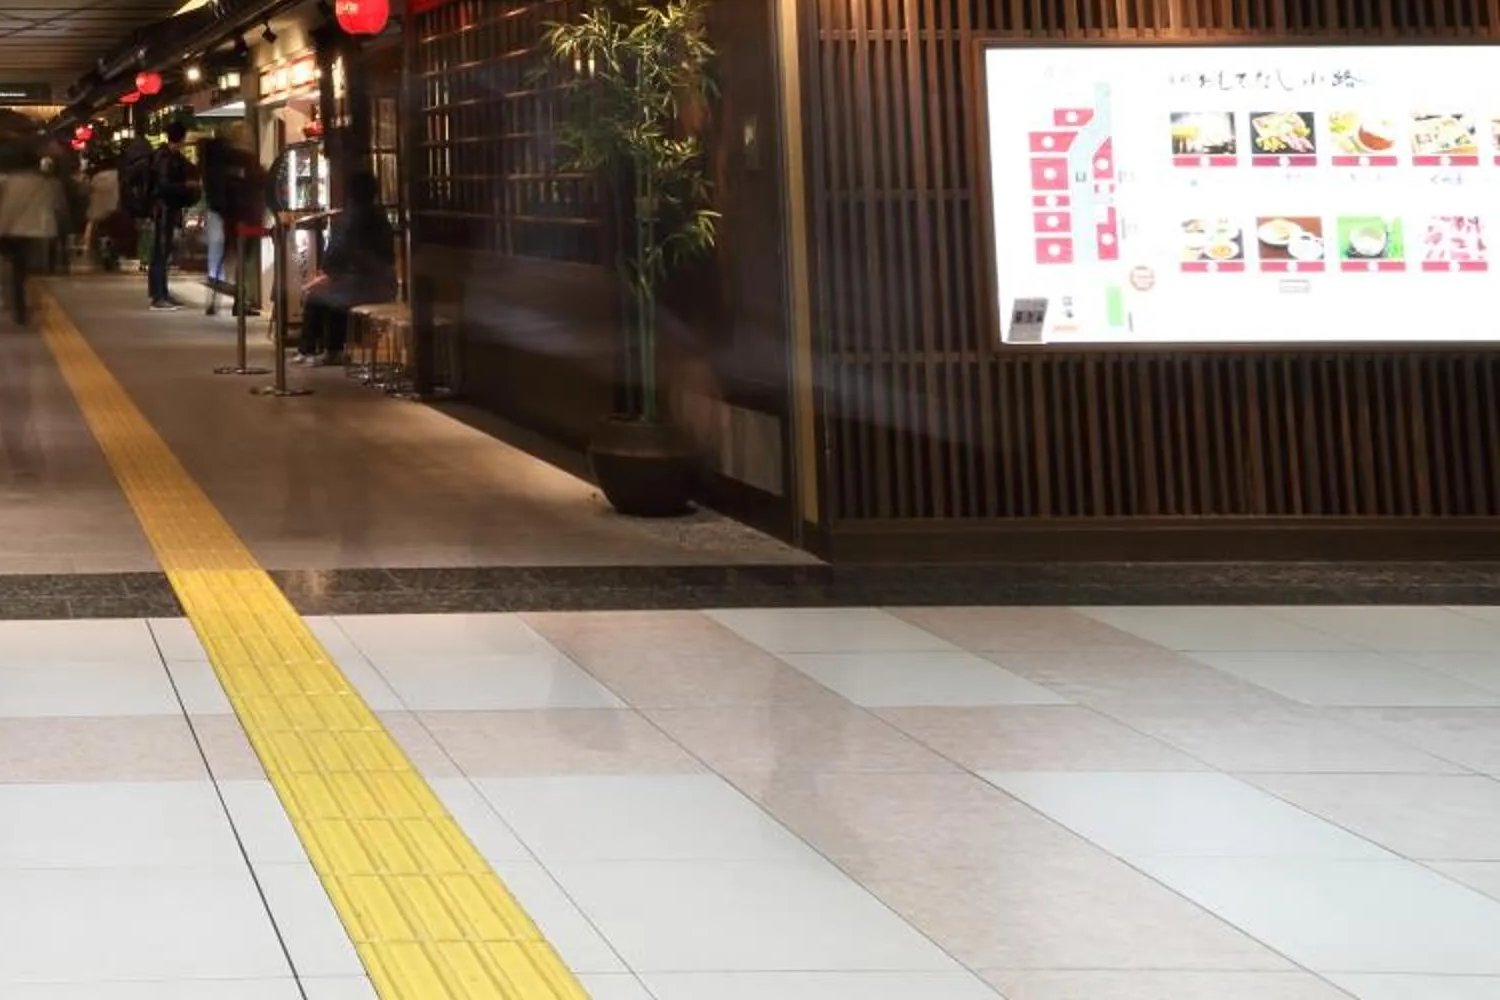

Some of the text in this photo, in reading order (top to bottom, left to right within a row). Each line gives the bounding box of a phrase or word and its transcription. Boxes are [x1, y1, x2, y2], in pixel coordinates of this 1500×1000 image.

[1168, 66, 1366, 92] おもてなし小路
